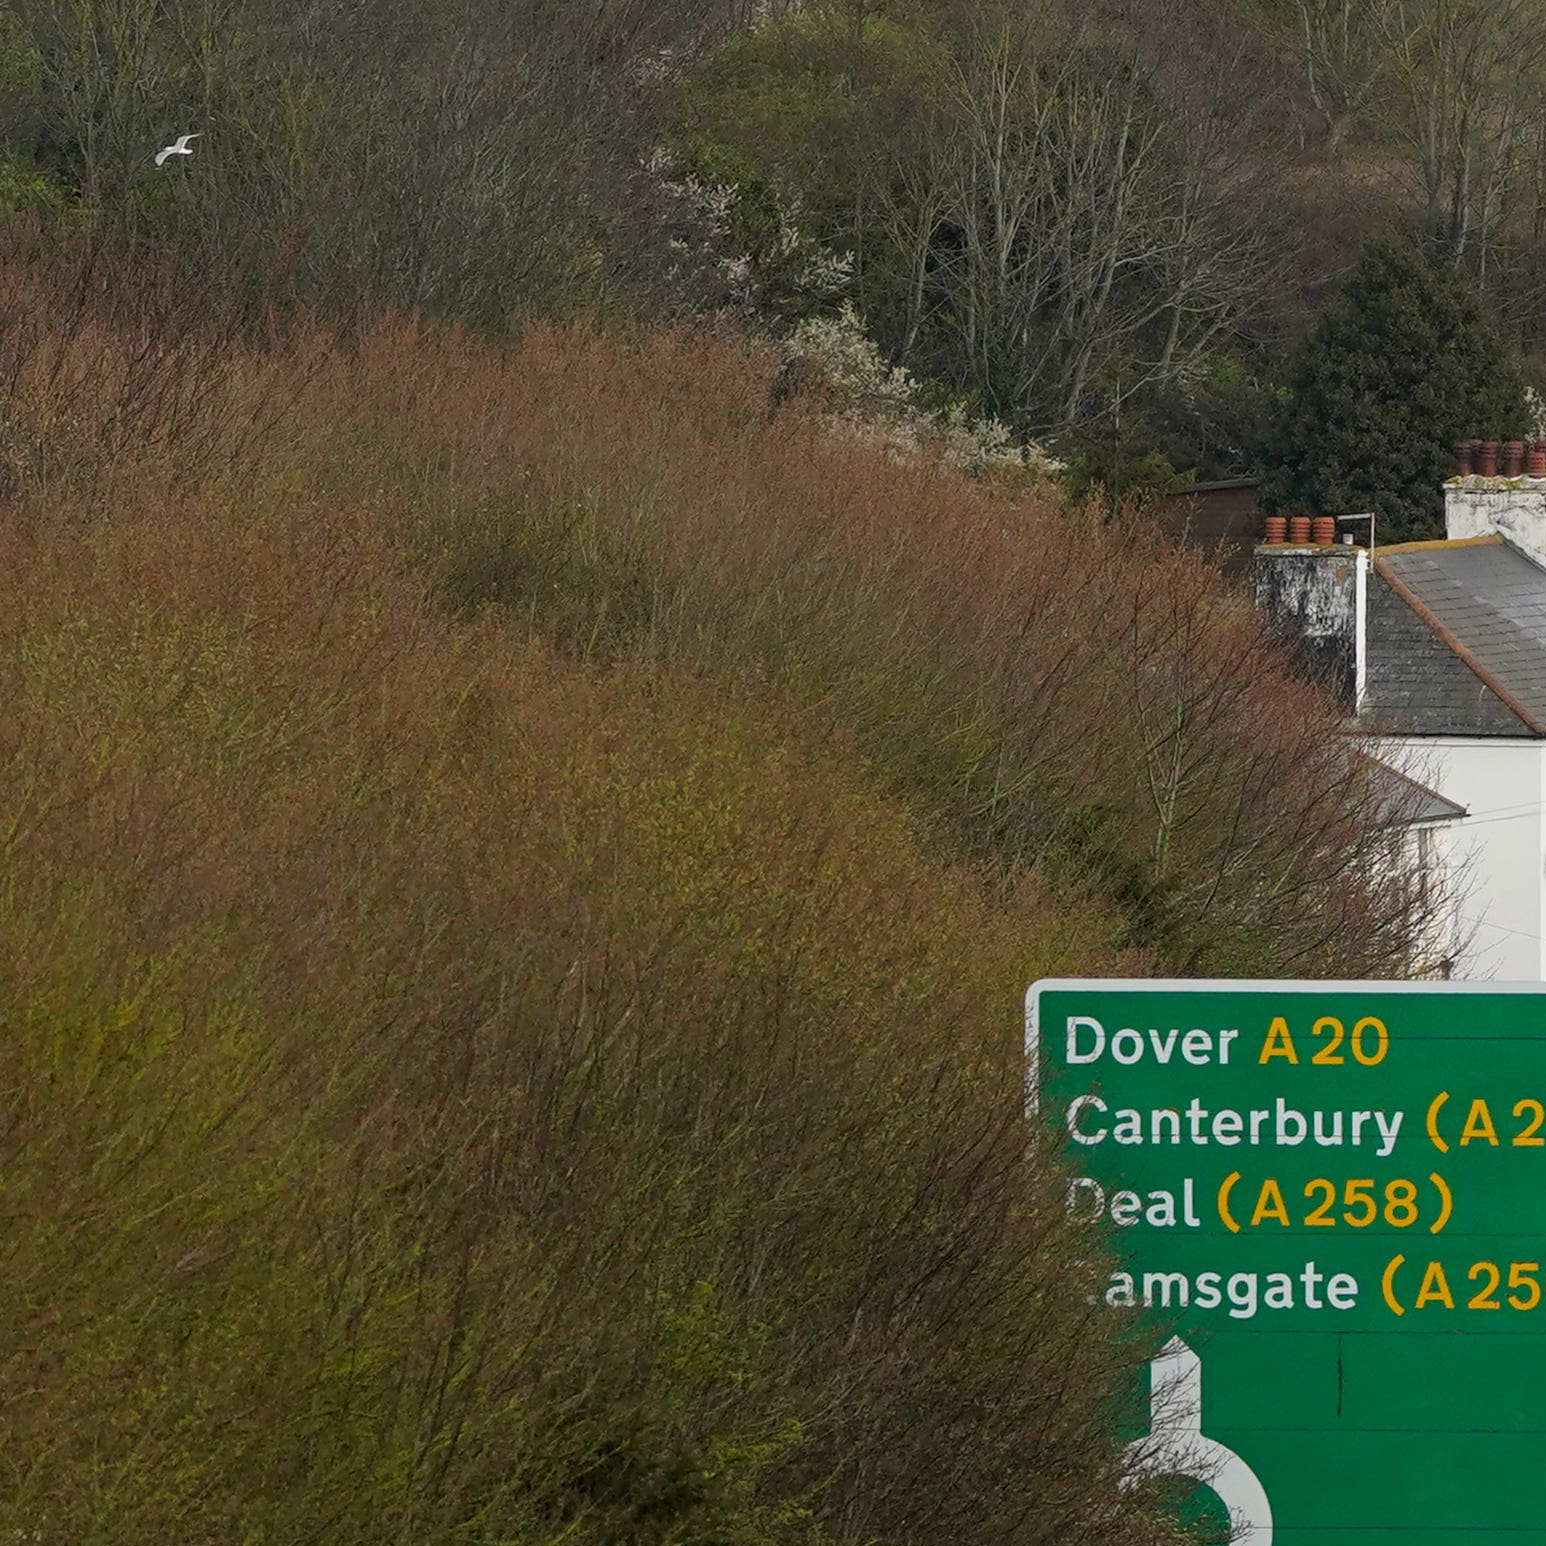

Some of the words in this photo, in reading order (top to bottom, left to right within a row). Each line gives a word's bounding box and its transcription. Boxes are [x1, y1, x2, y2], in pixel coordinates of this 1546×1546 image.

[1065, 1016, 1239, 1066] Dover
[1258, 1016, 1390, 1067] A20
[1065, 1095, 1403, 1156] Canterbury
[1065, 1177, 1200, 1227] Deal
[1217, 1172, 1452, 1233] (A258)
[1065, 1260, 1358, 1319] amsgate
